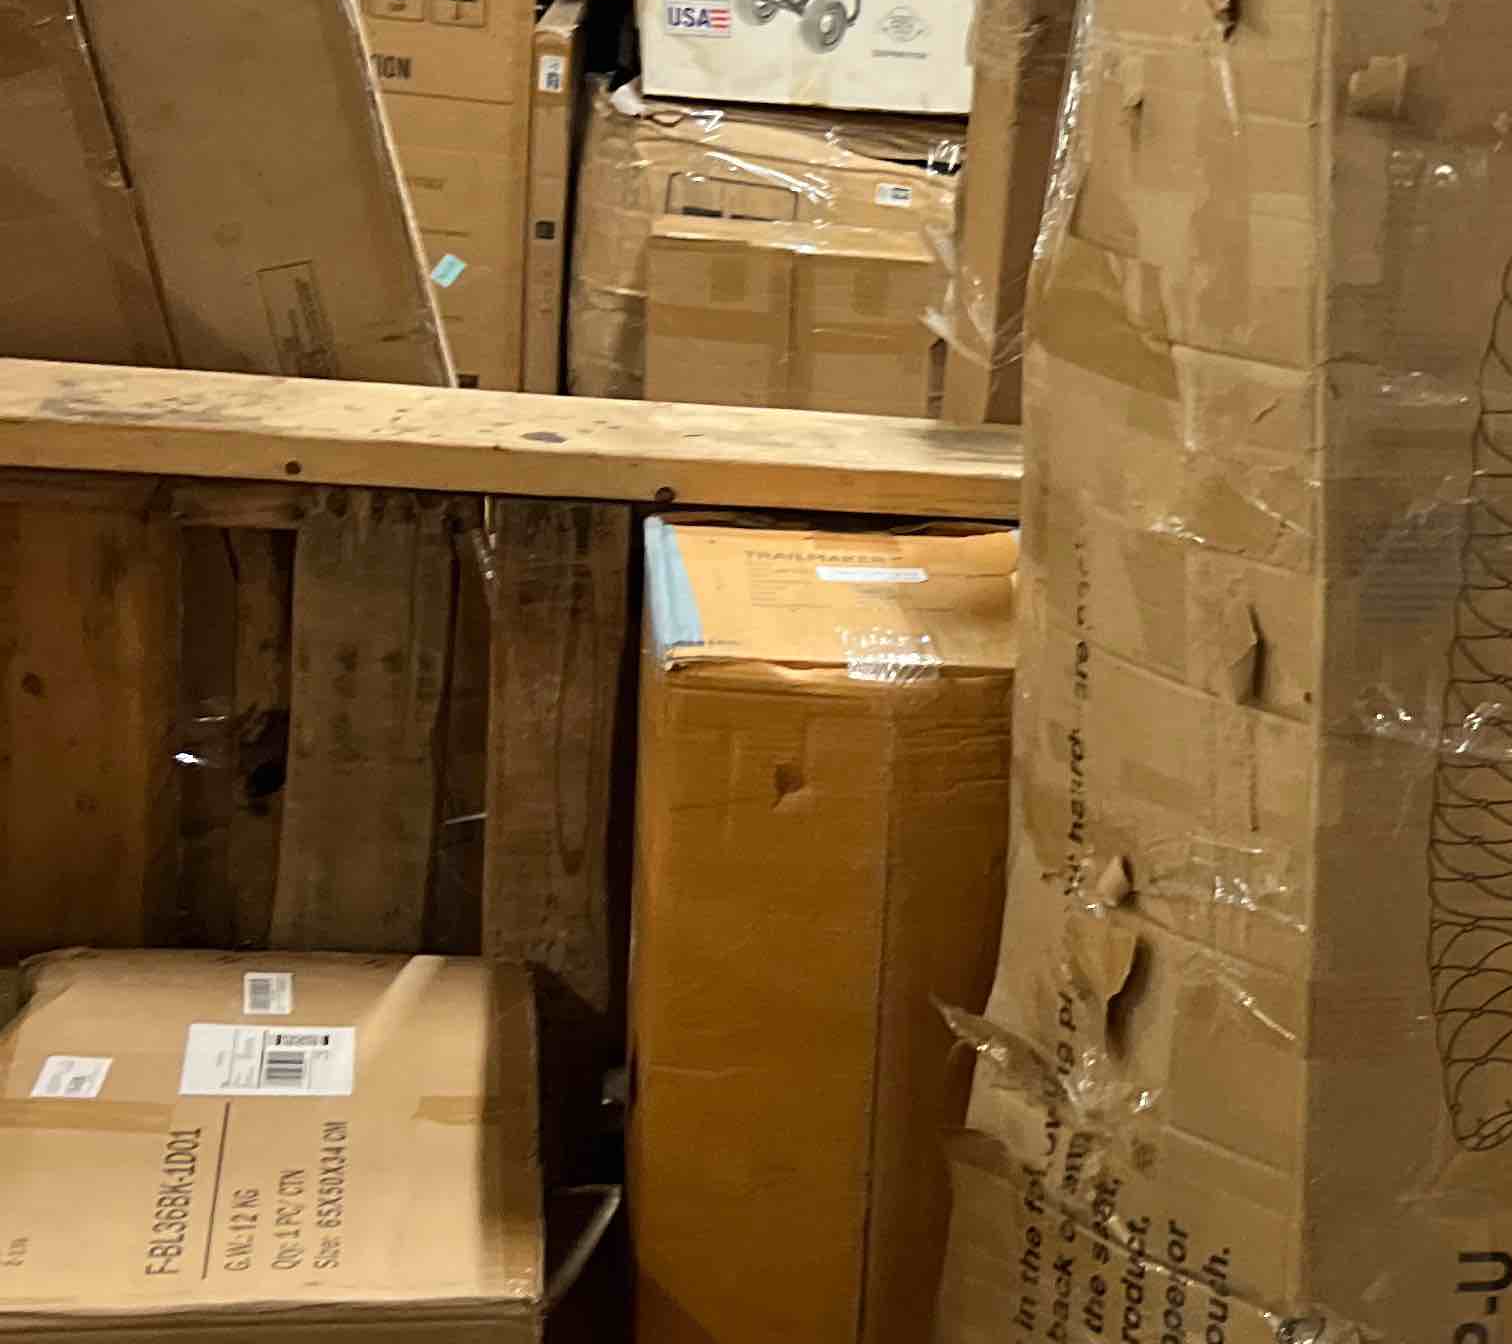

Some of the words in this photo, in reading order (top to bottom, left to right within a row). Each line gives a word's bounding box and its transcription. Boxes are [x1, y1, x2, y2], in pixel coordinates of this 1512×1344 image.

[667, 6, 712, 28] USA
[321, 1120, 348, 1143] CM
[277, 1169, 305, 1197] CTN
[1017, 1225, 1043, 1286] the
[1165, 1219, 1189, 1264] or
[1013, 1296, 1037, 1332] in
[1080, 1274, 1107, 1335] the
